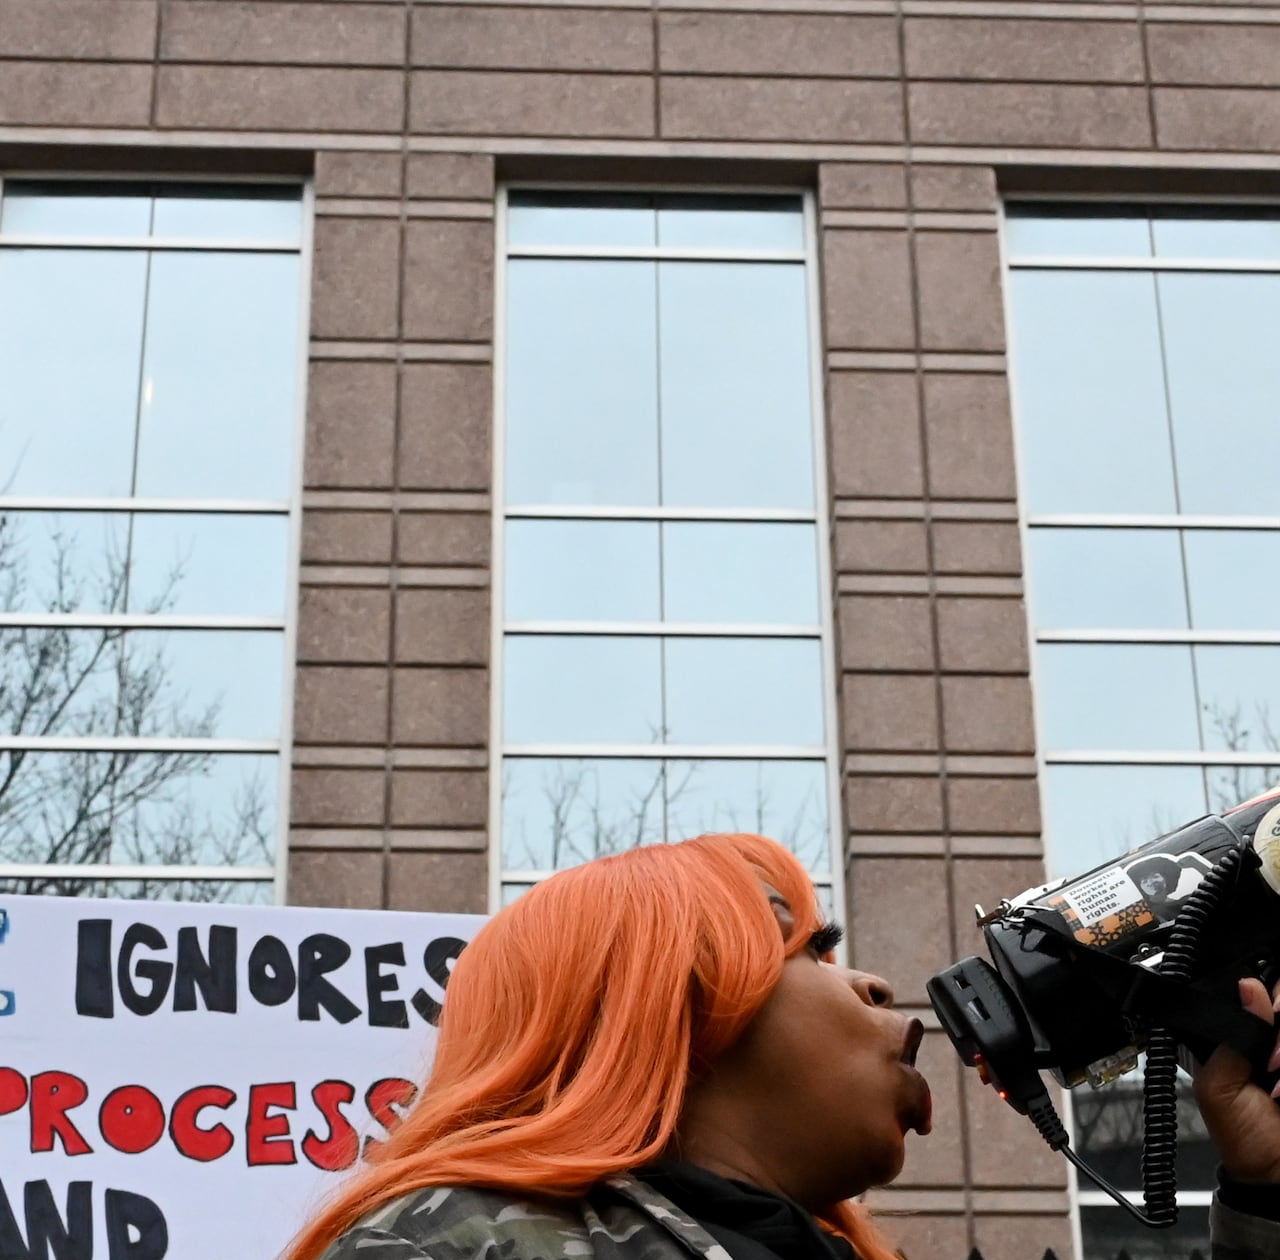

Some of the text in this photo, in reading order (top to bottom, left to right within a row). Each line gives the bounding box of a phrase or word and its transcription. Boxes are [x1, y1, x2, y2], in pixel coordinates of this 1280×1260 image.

[1073, 882, 1108, 900] worker
[1077, 879, 1125, 906] rights are
[1081, 892, 1117, 913] human
[1086, 900, 1120, 920] rights.
[75, 917, 469, 1028] IGNORES
